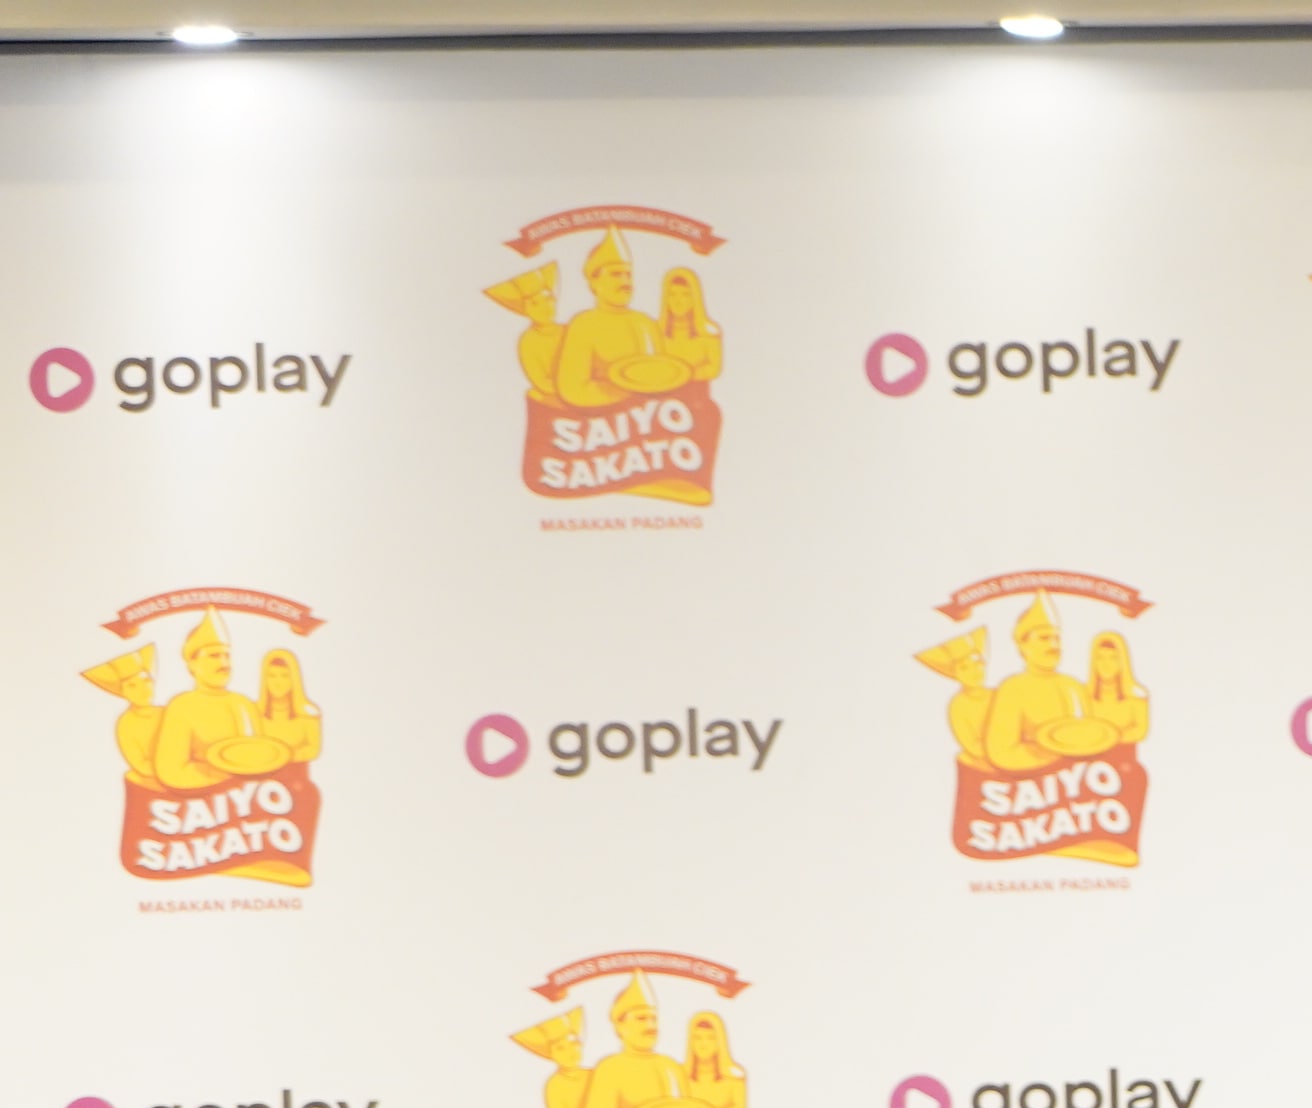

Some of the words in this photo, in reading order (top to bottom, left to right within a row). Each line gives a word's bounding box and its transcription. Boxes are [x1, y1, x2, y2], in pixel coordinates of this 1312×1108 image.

[113, 342, 352, 413] goplay
[947, 327, 1180, 398] goplay
[552, 398, 694, 453] SAIYO
[539, 436, 704, 490] SAKATO
[548, 707, 782, 778] goplay
[150, 779, 293, 835] SAIYO
[981, 760, 1121, 816] SAIYO
[137, 817, 303, 871] SAKATO
[969, 798, 1131, 852] SAKATO
